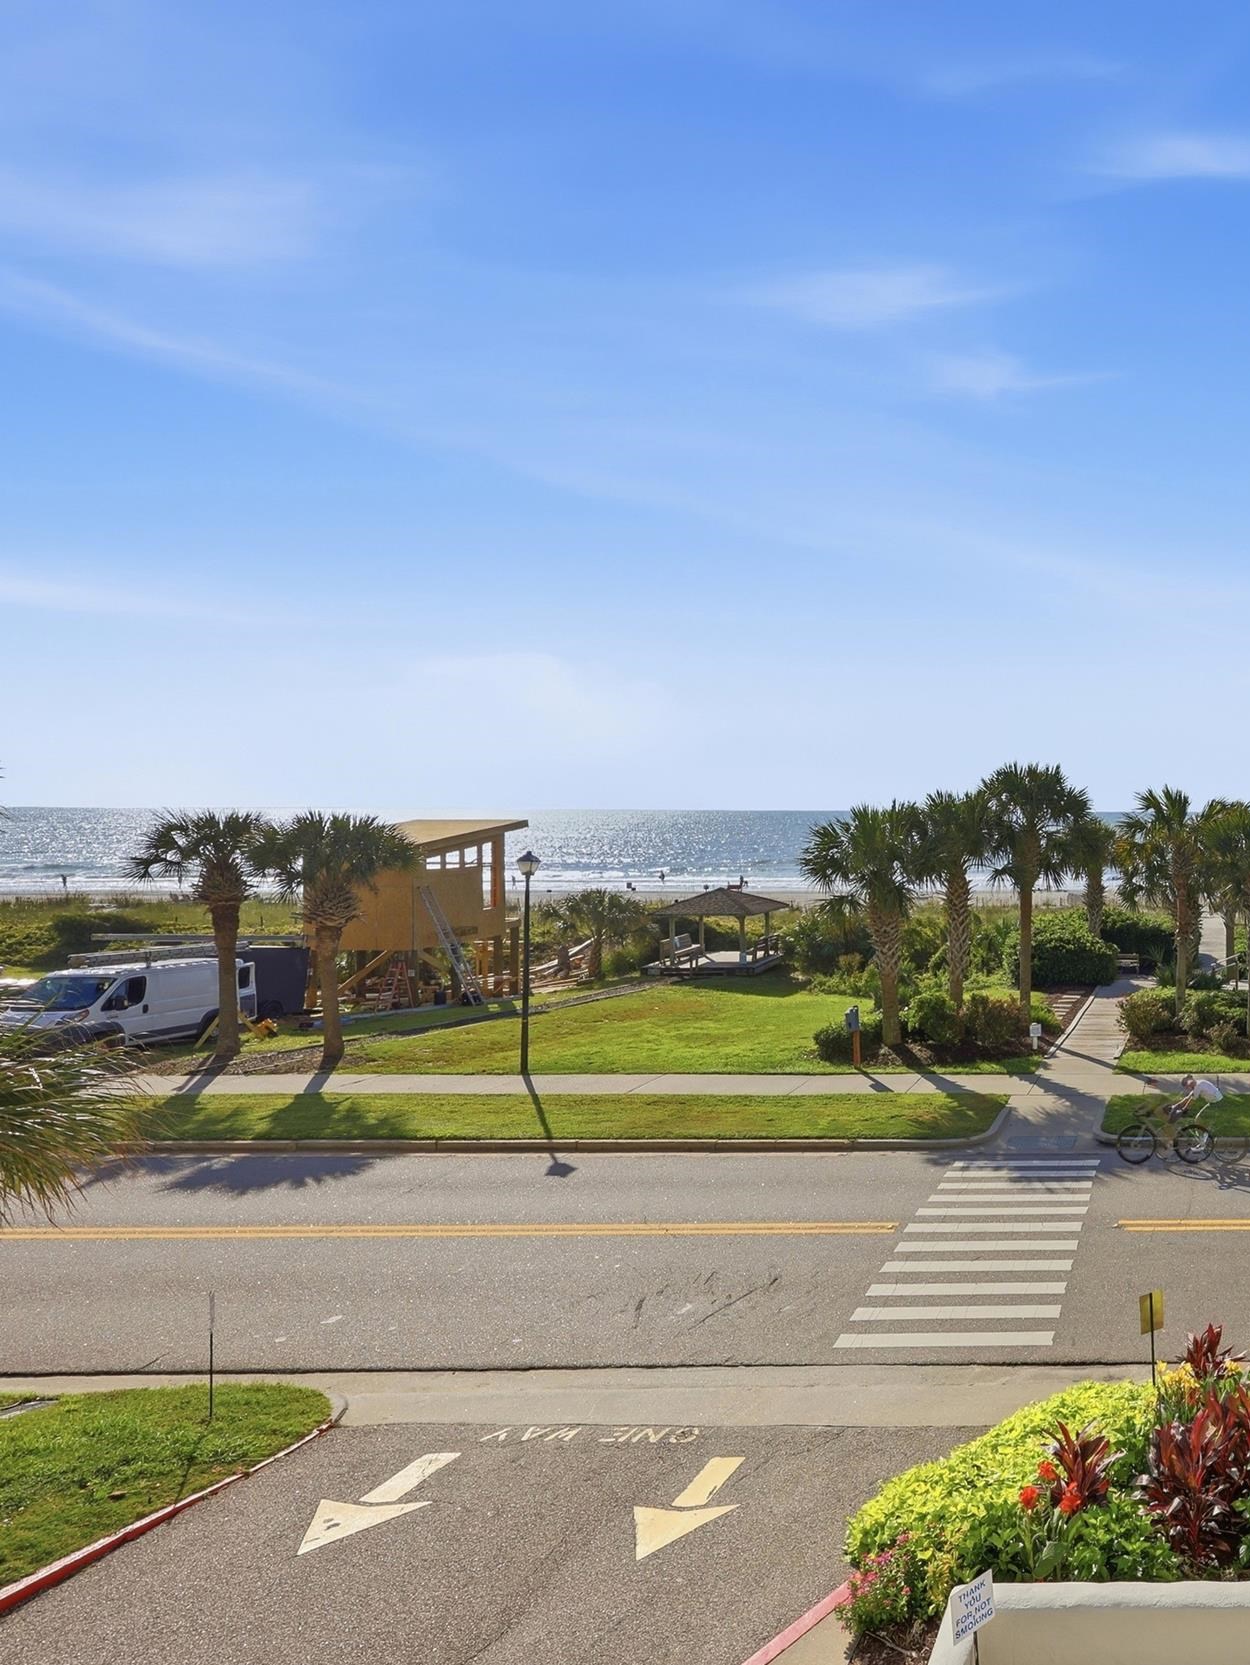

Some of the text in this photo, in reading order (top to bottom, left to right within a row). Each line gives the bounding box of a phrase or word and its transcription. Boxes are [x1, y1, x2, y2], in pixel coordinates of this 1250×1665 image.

[479, 1426, 700, 1444] ONE WAY
[958, 1579, 986, 1602] THANK
[964, 1593, 982, 1610] YOU
[955, 1607, 993, 1639] SMOKING
[956, 1597, 992, 1627] FOR NOT
